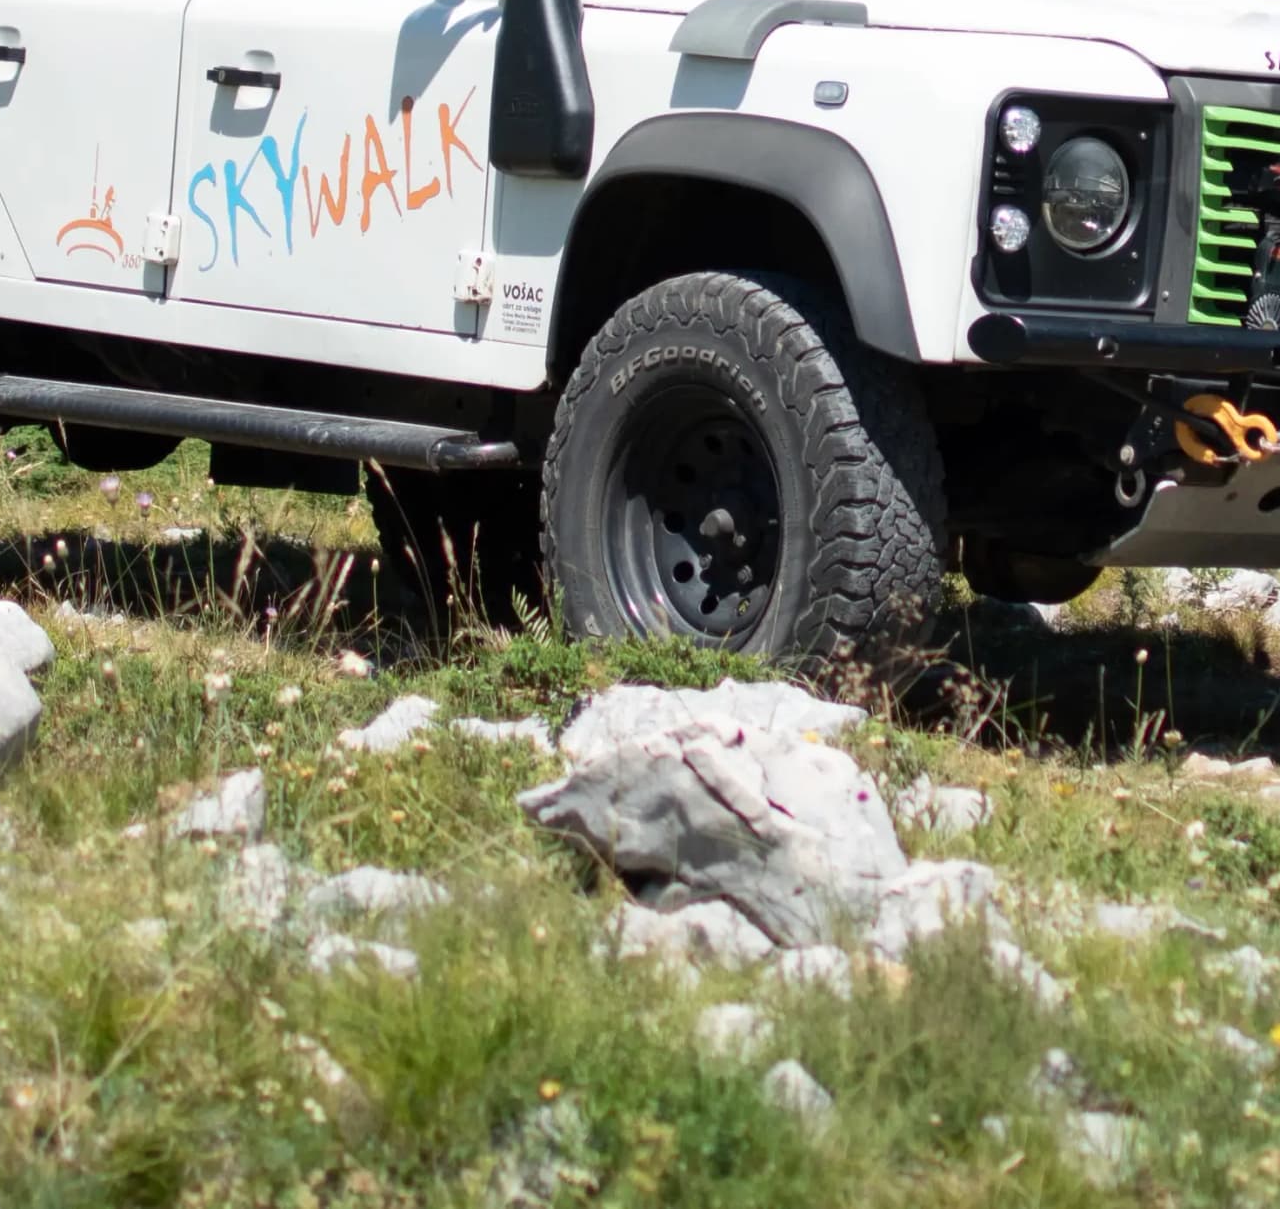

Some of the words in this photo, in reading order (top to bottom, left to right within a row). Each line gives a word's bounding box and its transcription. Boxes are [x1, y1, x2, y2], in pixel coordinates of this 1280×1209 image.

[187, 85, 484, 272] SKYWALK
[503, 282, 544, 302] VOŠAC
[610, 345, 768, 413] BFGoodrich
